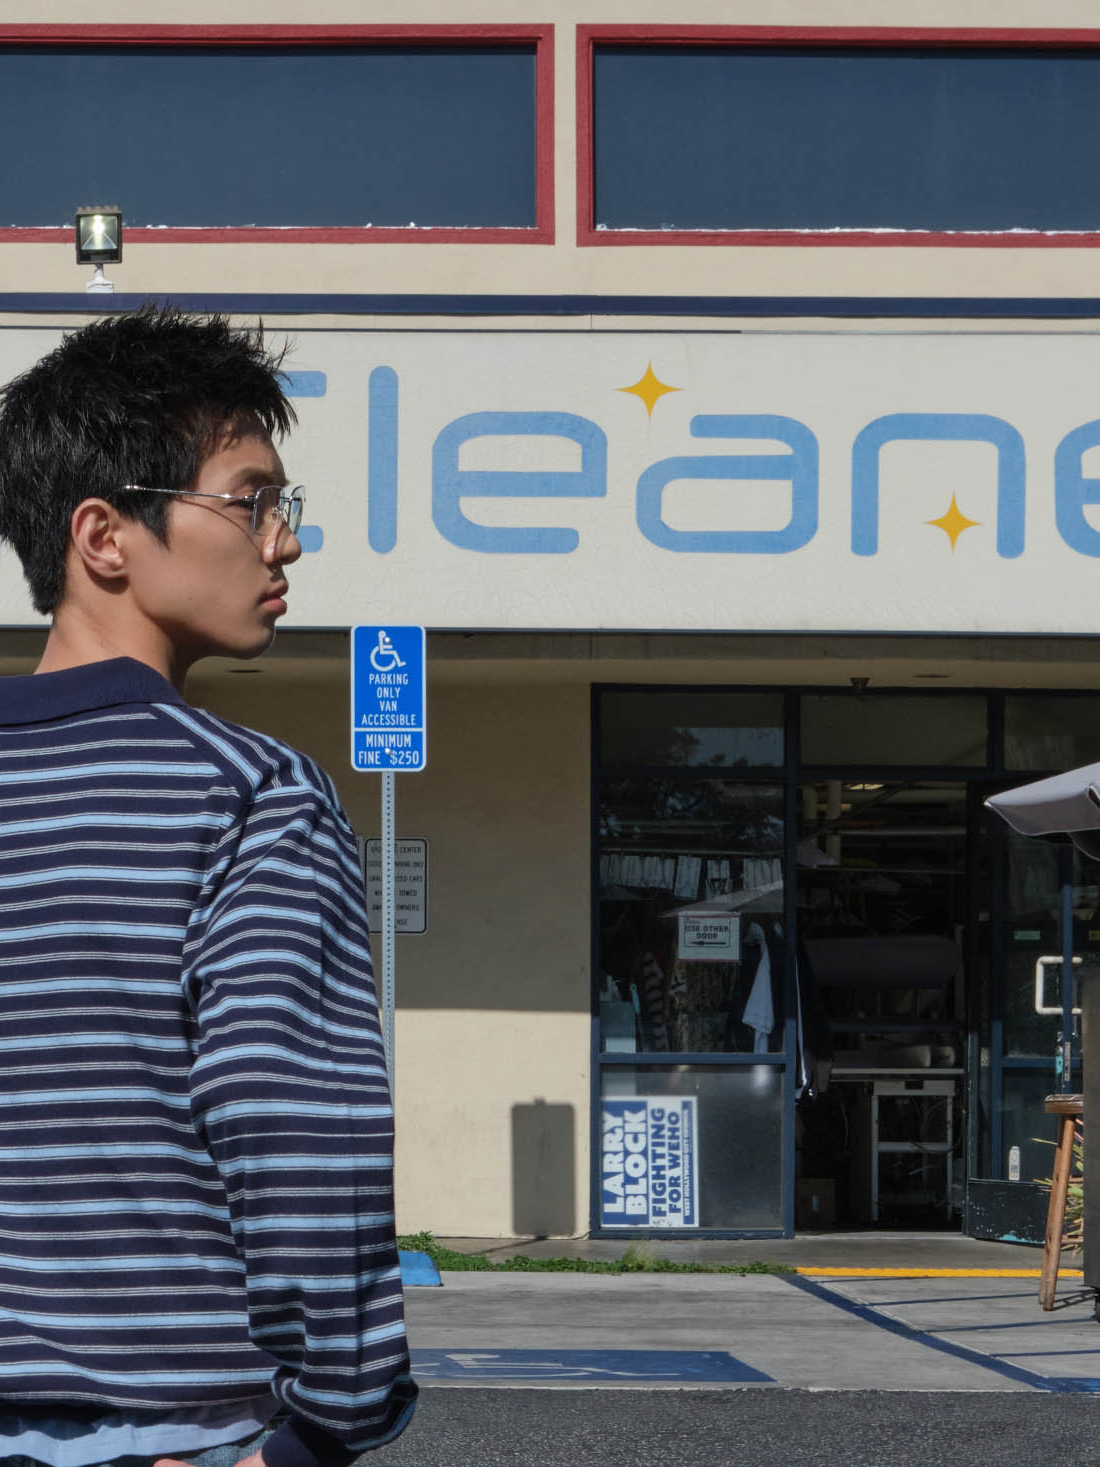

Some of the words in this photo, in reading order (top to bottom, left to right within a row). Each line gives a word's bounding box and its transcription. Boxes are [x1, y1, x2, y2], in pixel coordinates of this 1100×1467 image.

[276, 366, 1100, 559] lean
[369, 673, 408, 685] PARKING
[376, 687, 401, 698] ONLY
[379, 700, 398, 712] VAN
[361, 714, 416, 726] ACCESSIBLE
[365, 734, 412, 747] MINIMUM
[358, 751, 381, 765] FINE
[389, 750, 420, 765] $250
[667, 1111, 681, 1170] WEHO
[603, 1111, 624, 1213] LARRY
[623, 1109, 647, 1215] BLOCK
[651, 1107, 666, 1217] FIGHTING
[668, 1175, 681, 1213] FOR
